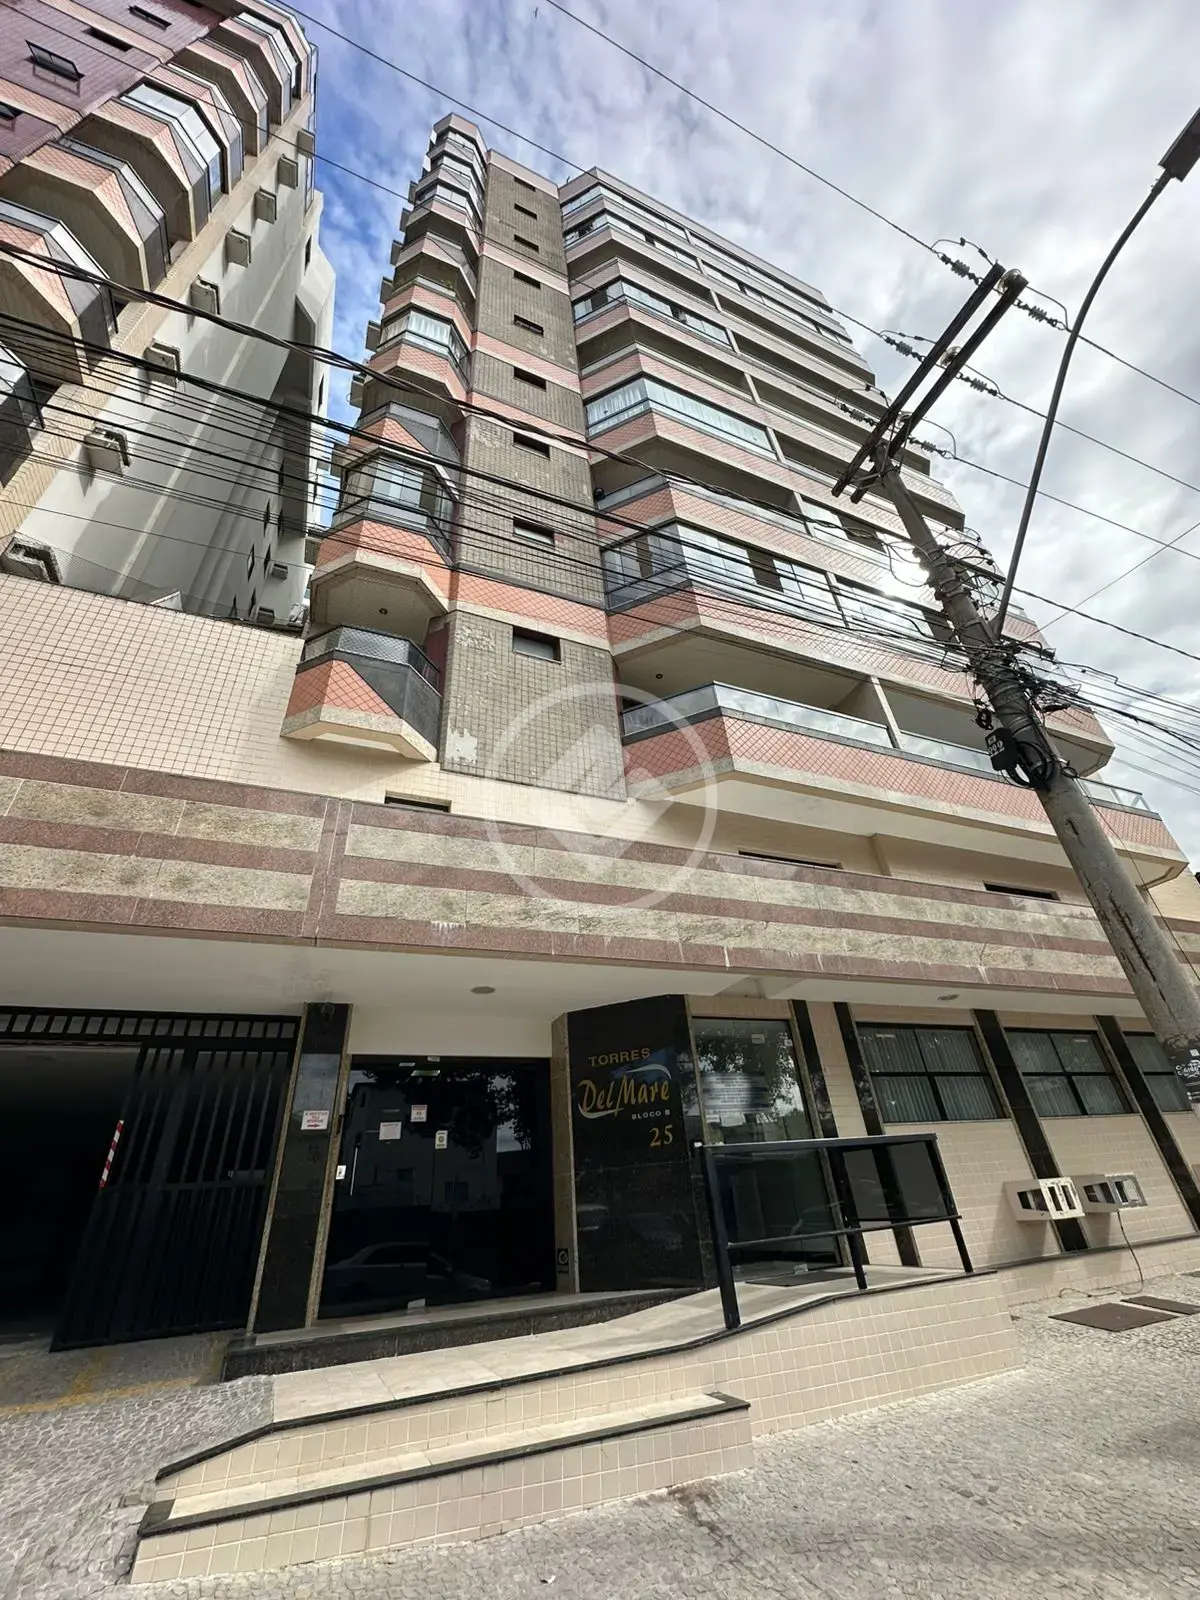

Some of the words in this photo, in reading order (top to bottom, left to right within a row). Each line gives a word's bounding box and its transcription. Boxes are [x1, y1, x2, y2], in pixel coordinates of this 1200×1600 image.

[589, 1047, 650, 1067] TORRES
[578, 1080, 615, 1114] Del
[632, 1110, 661, 1120] BLOCO
[649, 1124, 673, 1147] 25
